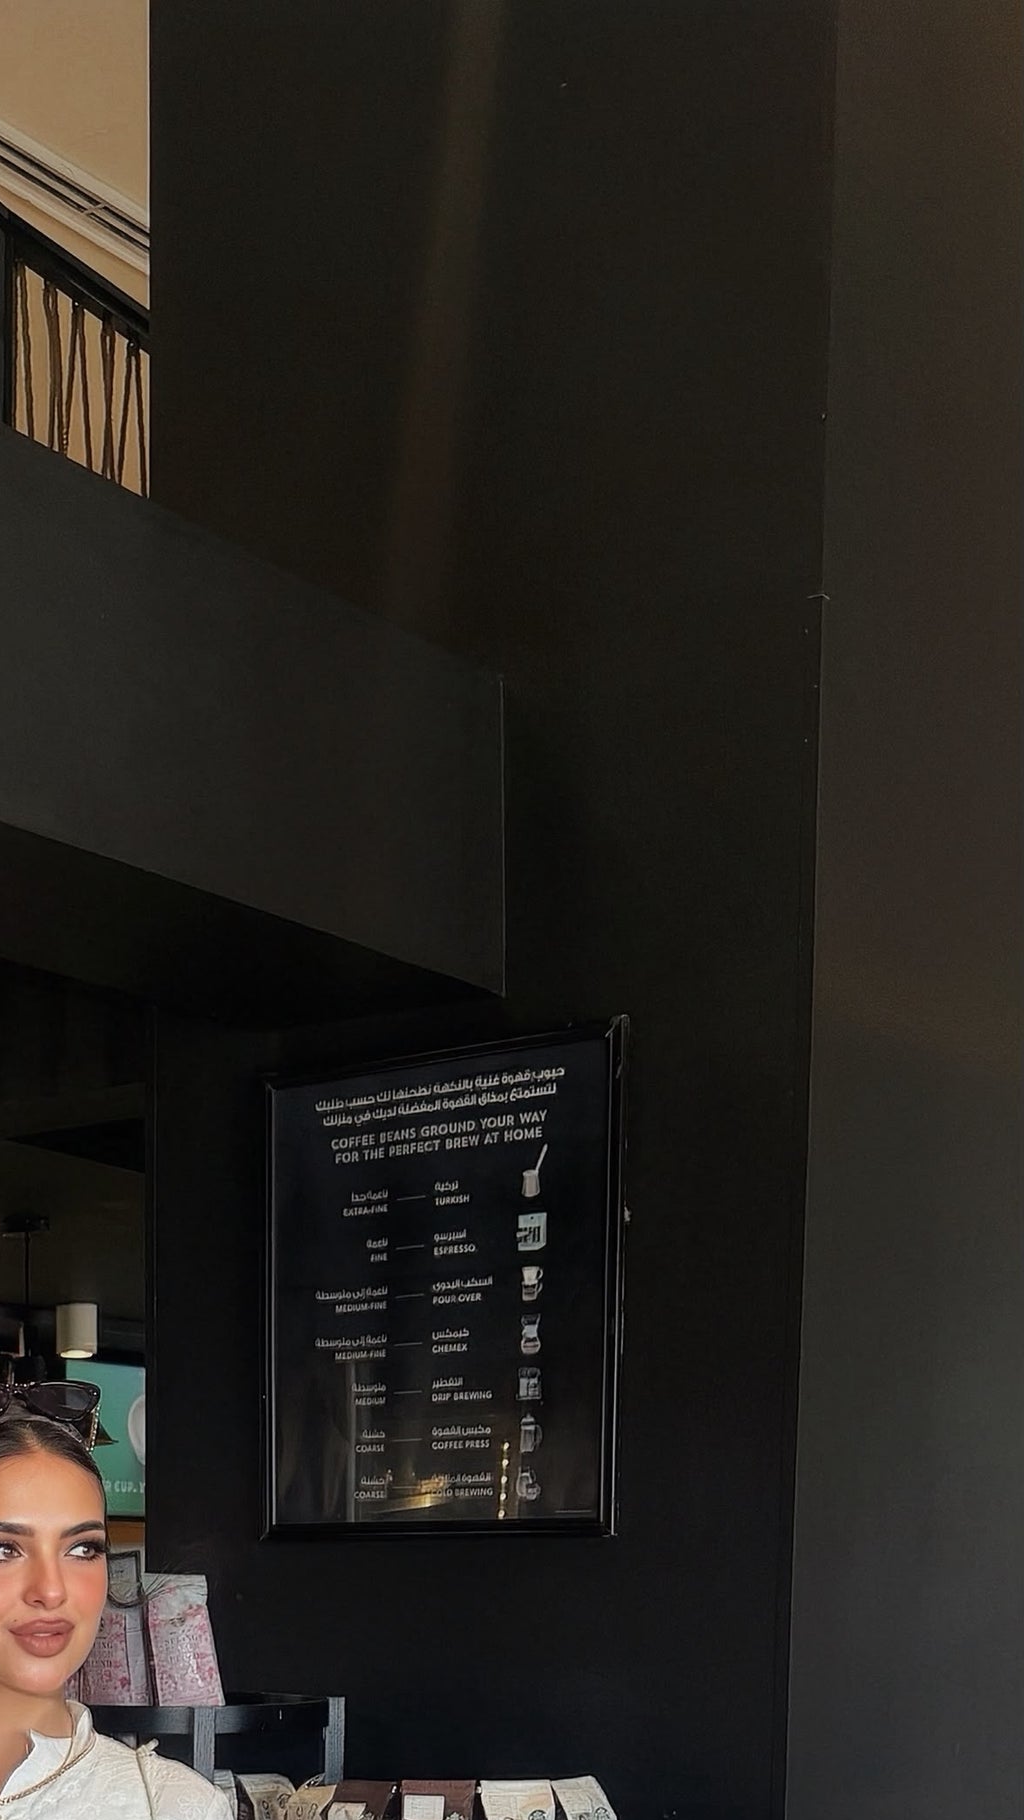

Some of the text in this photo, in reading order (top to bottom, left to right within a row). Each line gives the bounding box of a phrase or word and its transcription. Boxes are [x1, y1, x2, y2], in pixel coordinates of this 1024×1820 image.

[315, 1066, 565, 1113] حبوب قهوة غنية بالنكهة نطحنها لك حسب طلبك
[323, 1082, 557, 1127] لتستمتع بمذاق القهوة المفضلة لديك في منزلك
[331, 1109, 547, 1150] COFFEE BEANS GROUND YOUR WAY
[335, 1126, 542, 1164] FOR THE PERFECT BREW AT HOME
[435, 1195, 470, 1206] TURKISH
[342, 1204, 388, 1217] EXTRA-FINE
[433, 1244, 476, 1256] ESPRESSO
[370, 1253, 388, 1262] FINE
[432, 1293, 481, 1305] POUR OVER
[335, 1301, 387, 1313] MEDIUM-FINE
[432, 1343, 468, 1353] CHEMEX
[335, 1349, 387, 1360] MEDIUM-FINE
[355, 1397, 386, 1406] MEDIUM
[431, 1390, 493, 1402] DRIP BREWING
[355, 1444, 385, 1453] COARSE
[432, 1439, 490, 1450] COFFEE PRESS
[354, 1490, 384, 1499] COARSE
[454, 1487, 493, 1497] BREWING
